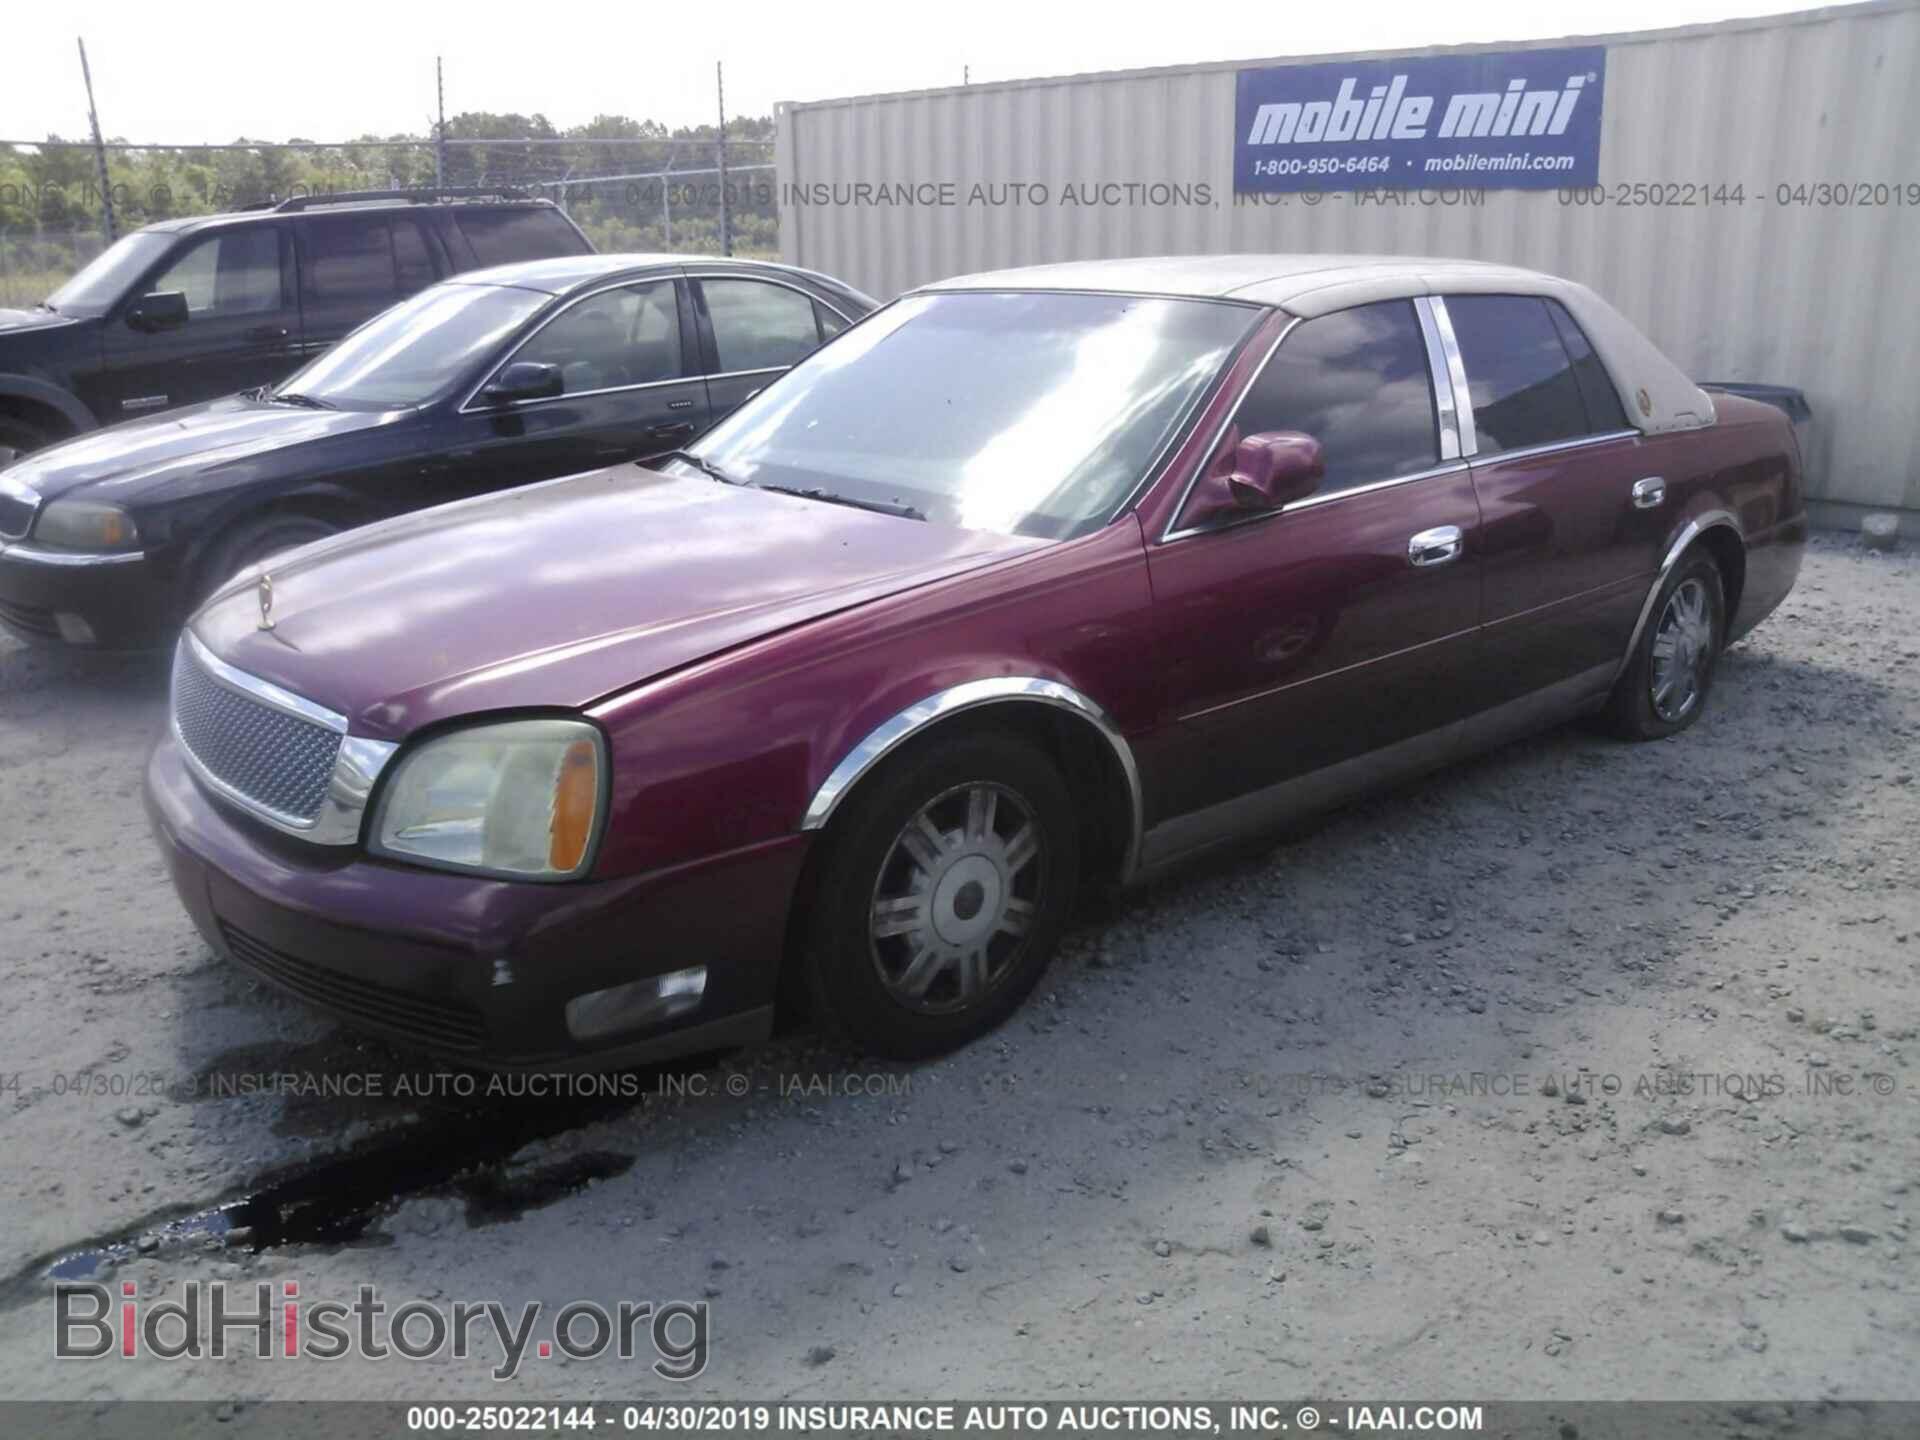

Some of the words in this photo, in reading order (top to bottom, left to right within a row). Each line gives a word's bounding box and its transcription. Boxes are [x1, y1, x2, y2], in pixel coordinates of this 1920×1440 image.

[1247, 74, 1433, 145] mobile
[1438, 76, 1586, 138] mini
[1254, 156, 1391, 175] 1-800-950-6464
[1424, 153, 1574, 171] mobilemini.com
